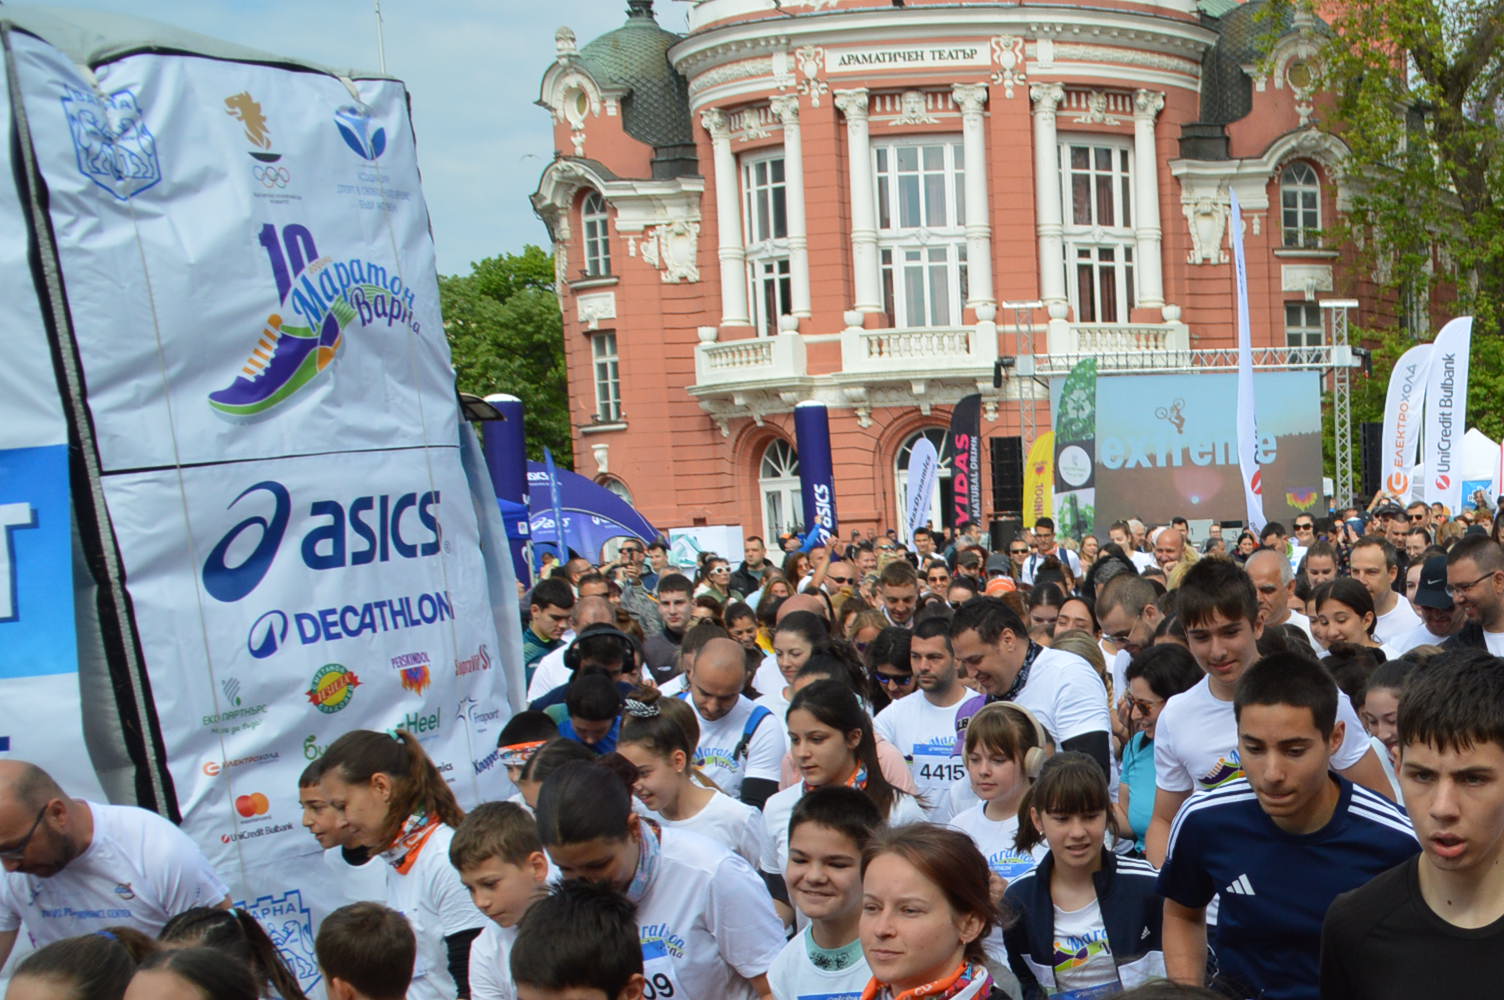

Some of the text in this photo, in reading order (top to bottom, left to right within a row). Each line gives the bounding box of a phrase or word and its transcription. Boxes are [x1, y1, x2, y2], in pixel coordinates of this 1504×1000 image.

[838, 48, 978, 67] ДРАМАТИЧЕН ТЕАТЪР
[292, 259, 416, 333] Маратон
[351, 287, 421, 335] Варна
[1437, 352, 1456, 473] UniCredit Bulbank
[301, 490, 442, 570] asics
[295, 590, 455, 646] DECATHLON
[920, 763, 966, 781] 4415
[231, 822, 294, 843] UniCredit Bulbank
[251, 903, 297, 922] АРНА
[641, 972, 675, 1000] 09
